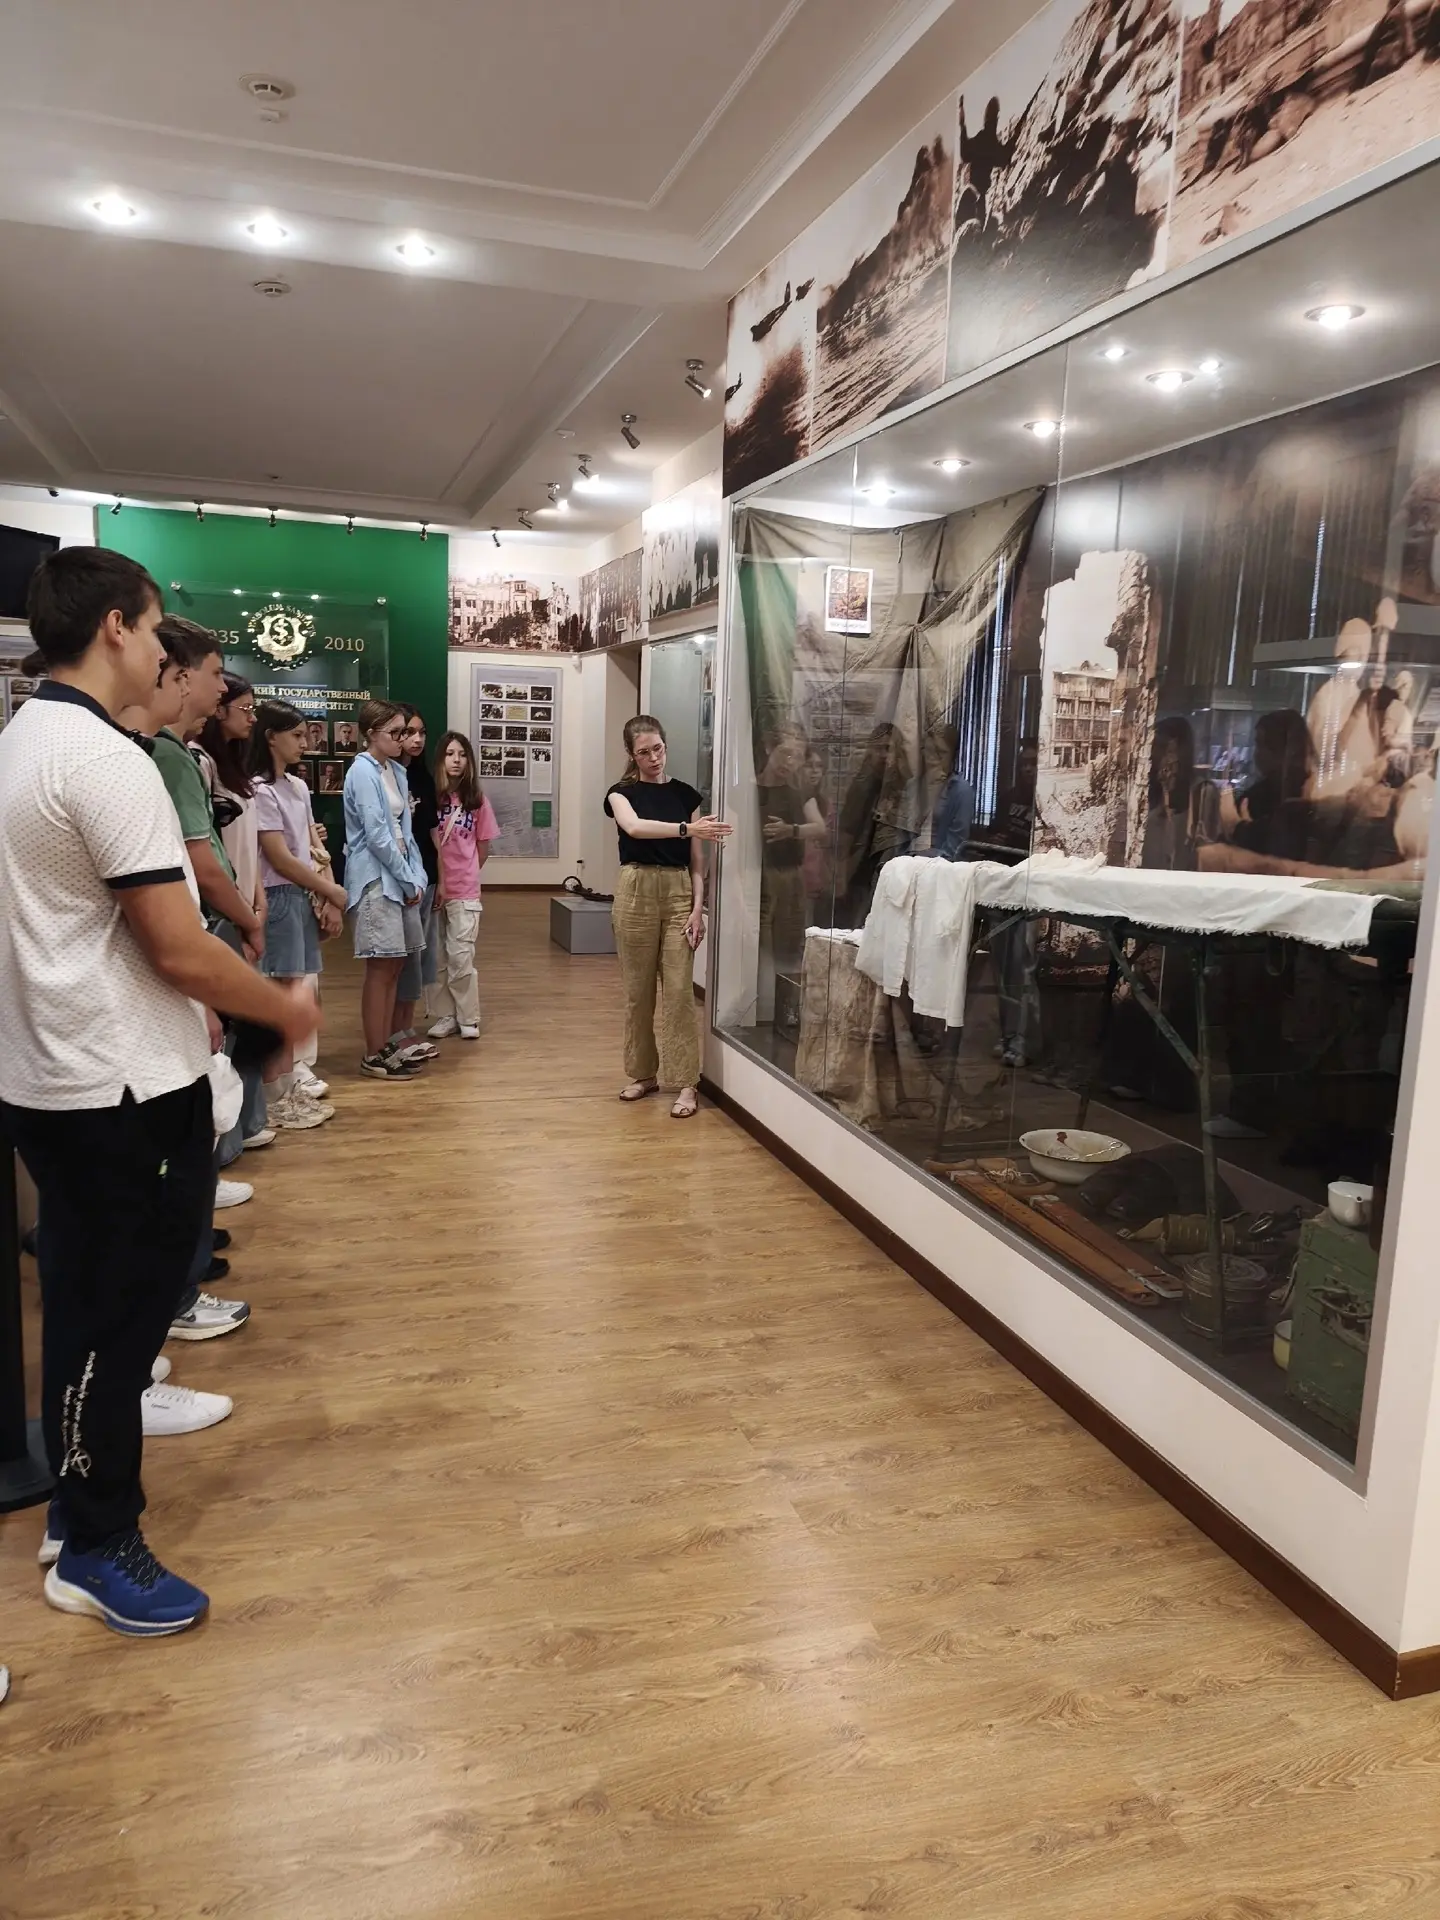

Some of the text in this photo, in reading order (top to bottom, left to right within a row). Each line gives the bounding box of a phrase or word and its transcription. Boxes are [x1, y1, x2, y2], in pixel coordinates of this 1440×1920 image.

[324, 636, 365, 652] 2010
[253, 685, 371, 701] КИЙ ГОСУДАРСТВЕННЫЙ
